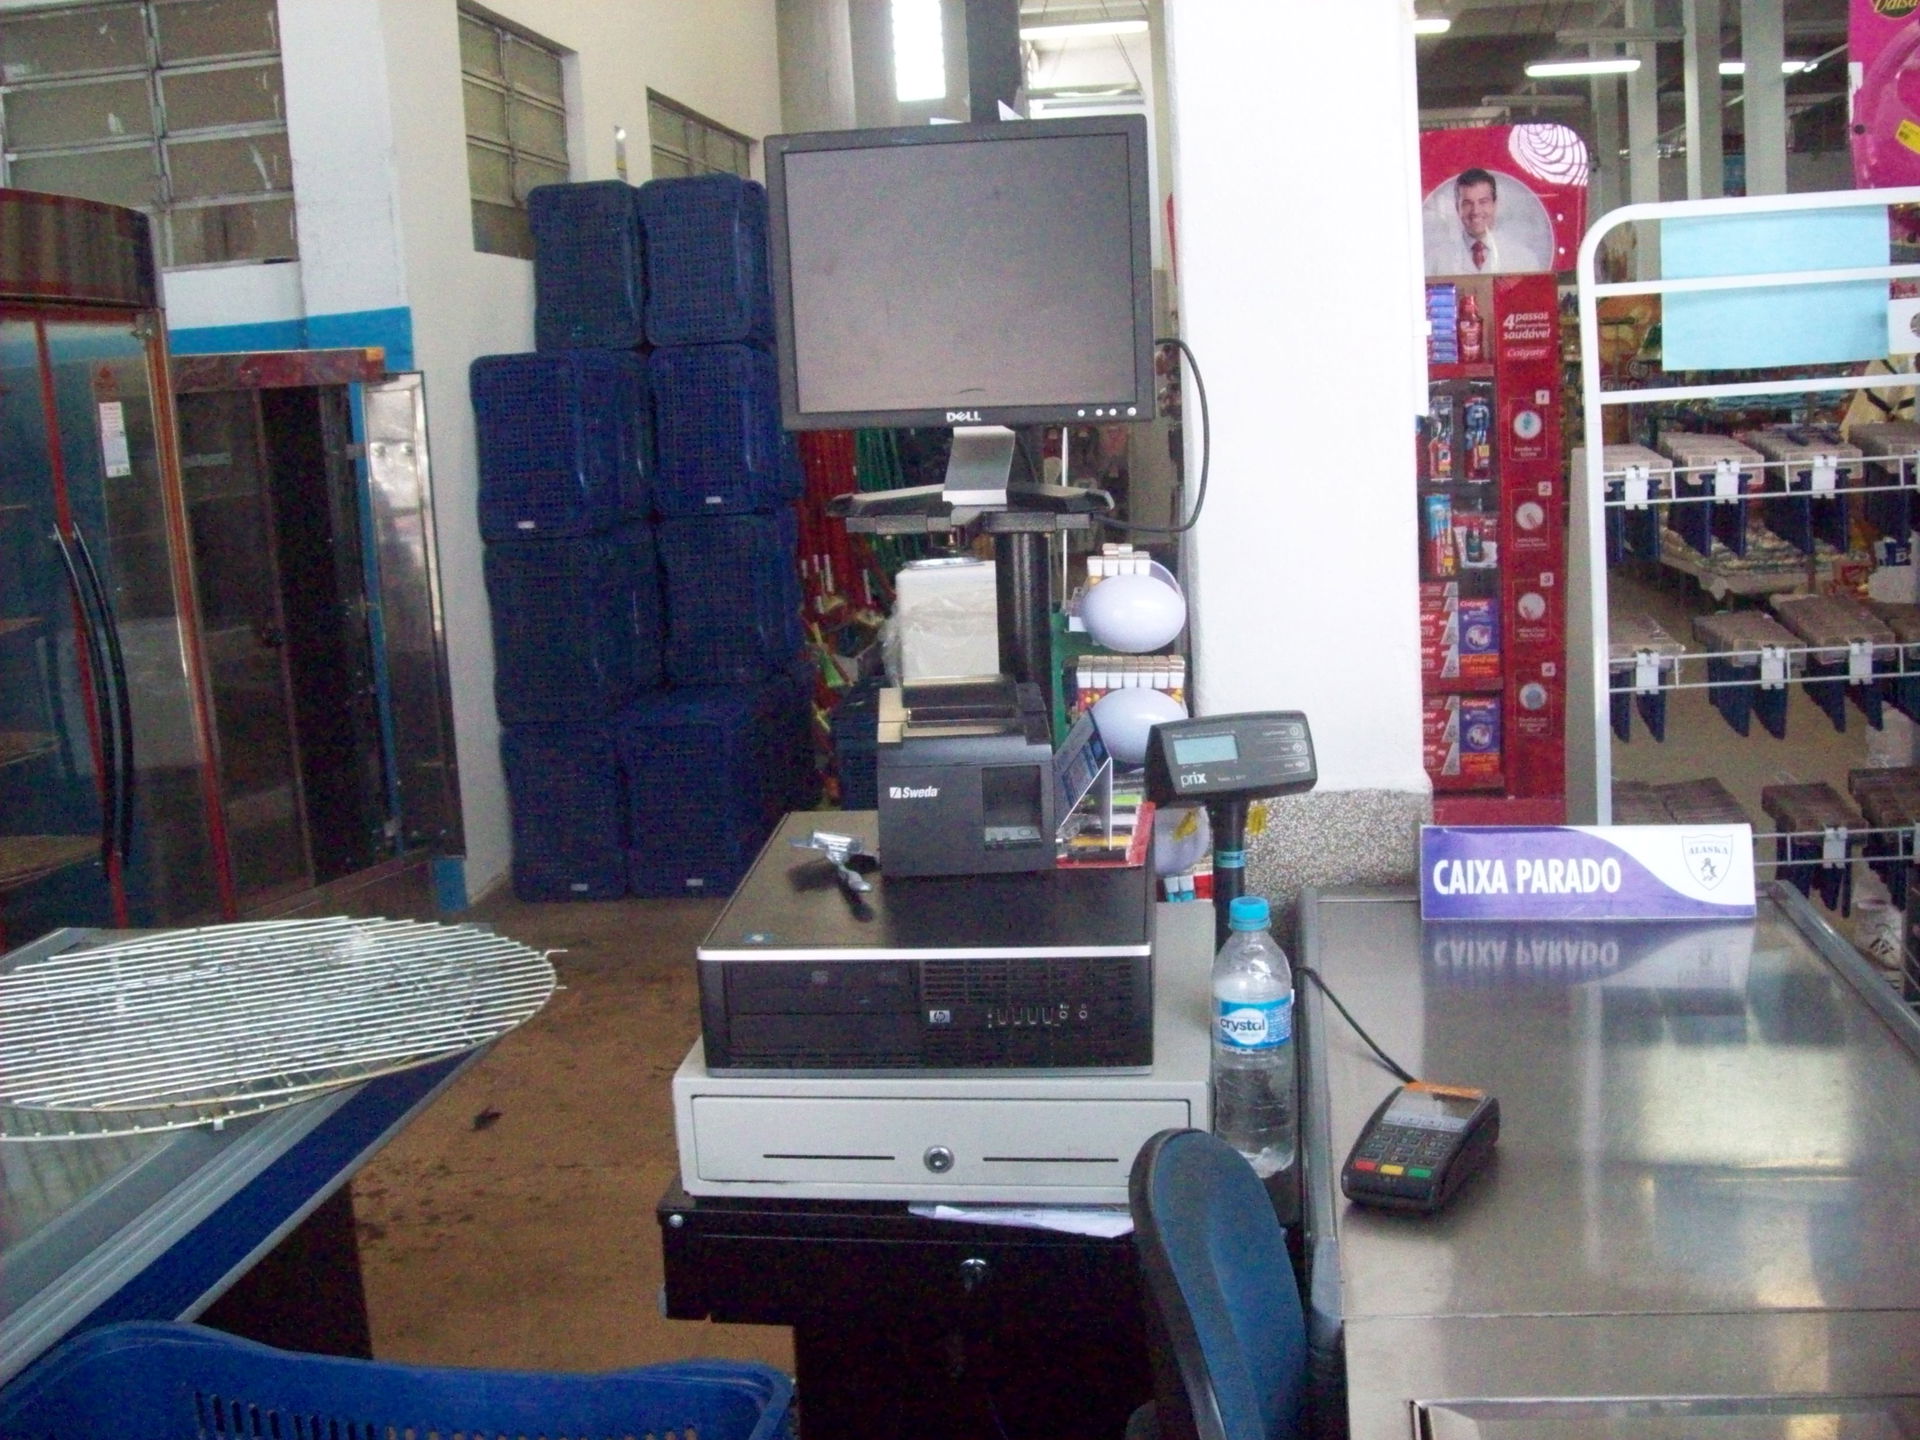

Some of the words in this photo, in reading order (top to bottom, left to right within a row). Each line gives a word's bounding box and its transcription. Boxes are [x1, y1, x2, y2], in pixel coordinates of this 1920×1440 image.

[1503, 313, 1515, 330] 4
[1515, 312, 1549, 322] passos
[1503, 328, 1551, 340] saudável
[946, 411, 982, 422] DELL
[1180, 771, 1207, 788] prix
[902, 786, 938, 798] Sweda
[1689, 846, 1728, 855] ALASKA
[1433, 859, 1508, 895] CAIXA
[1516, 858, 1622, 894] PARADO
[1219, 1018, 1265, 1032] crystal
